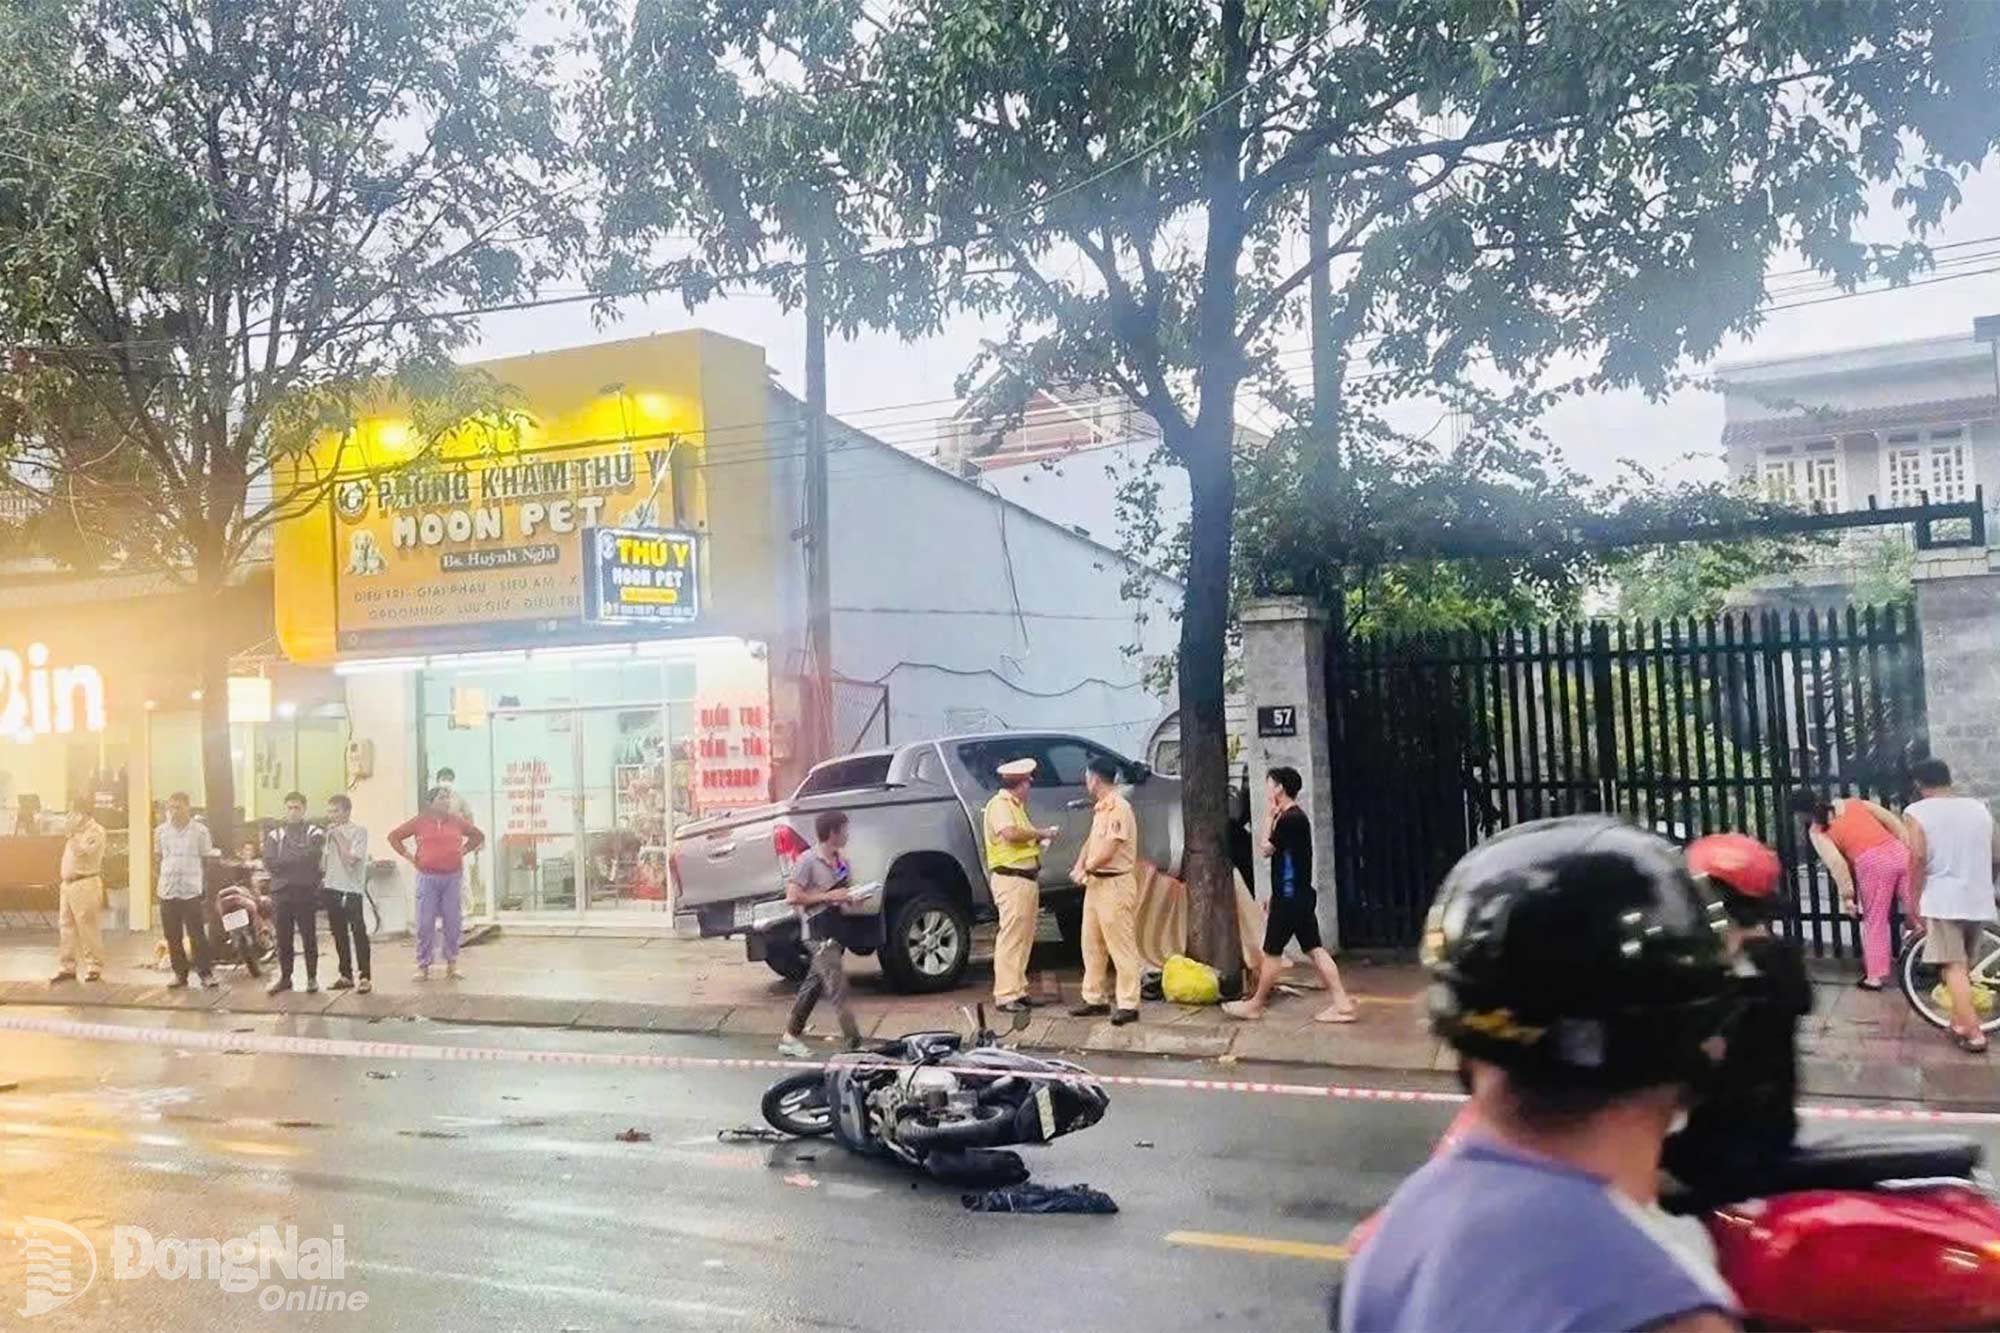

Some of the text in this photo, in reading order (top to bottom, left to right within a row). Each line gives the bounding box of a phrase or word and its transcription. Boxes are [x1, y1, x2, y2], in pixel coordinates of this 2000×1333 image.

[392, 496, 604, 547] MOON PET
[616, 537, 689, 568] THÚ Y
[612, 567, 683, 588] MOON PET
[1274, 709, 1292, 726] 57
